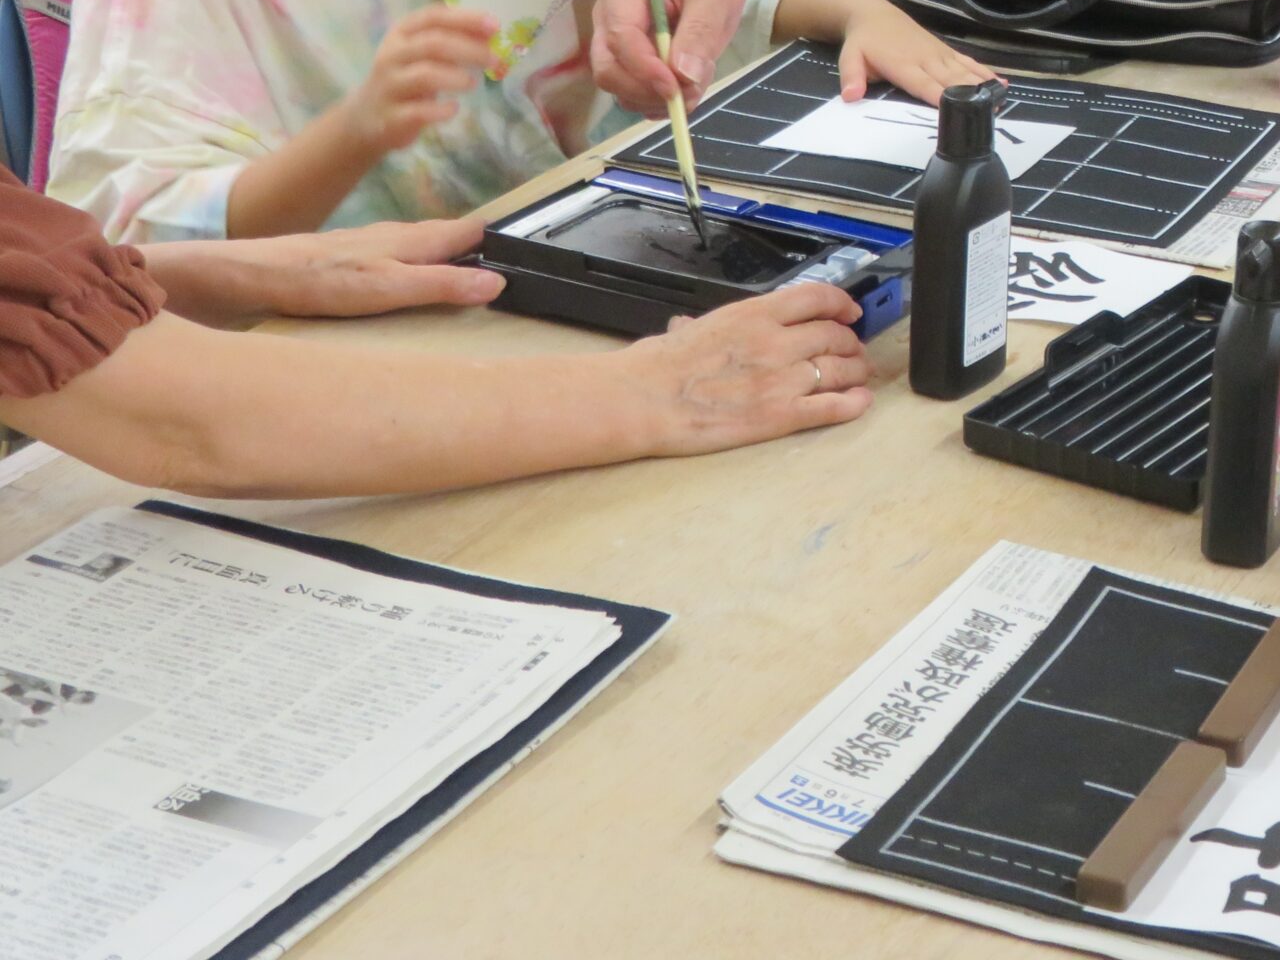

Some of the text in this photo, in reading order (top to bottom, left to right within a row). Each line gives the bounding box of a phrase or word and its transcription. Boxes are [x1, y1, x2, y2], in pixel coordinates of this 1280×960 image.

[822, 607, 1018, 780] 英労働党が政権奪還
[776, 787, 869, 829] IKKEI
